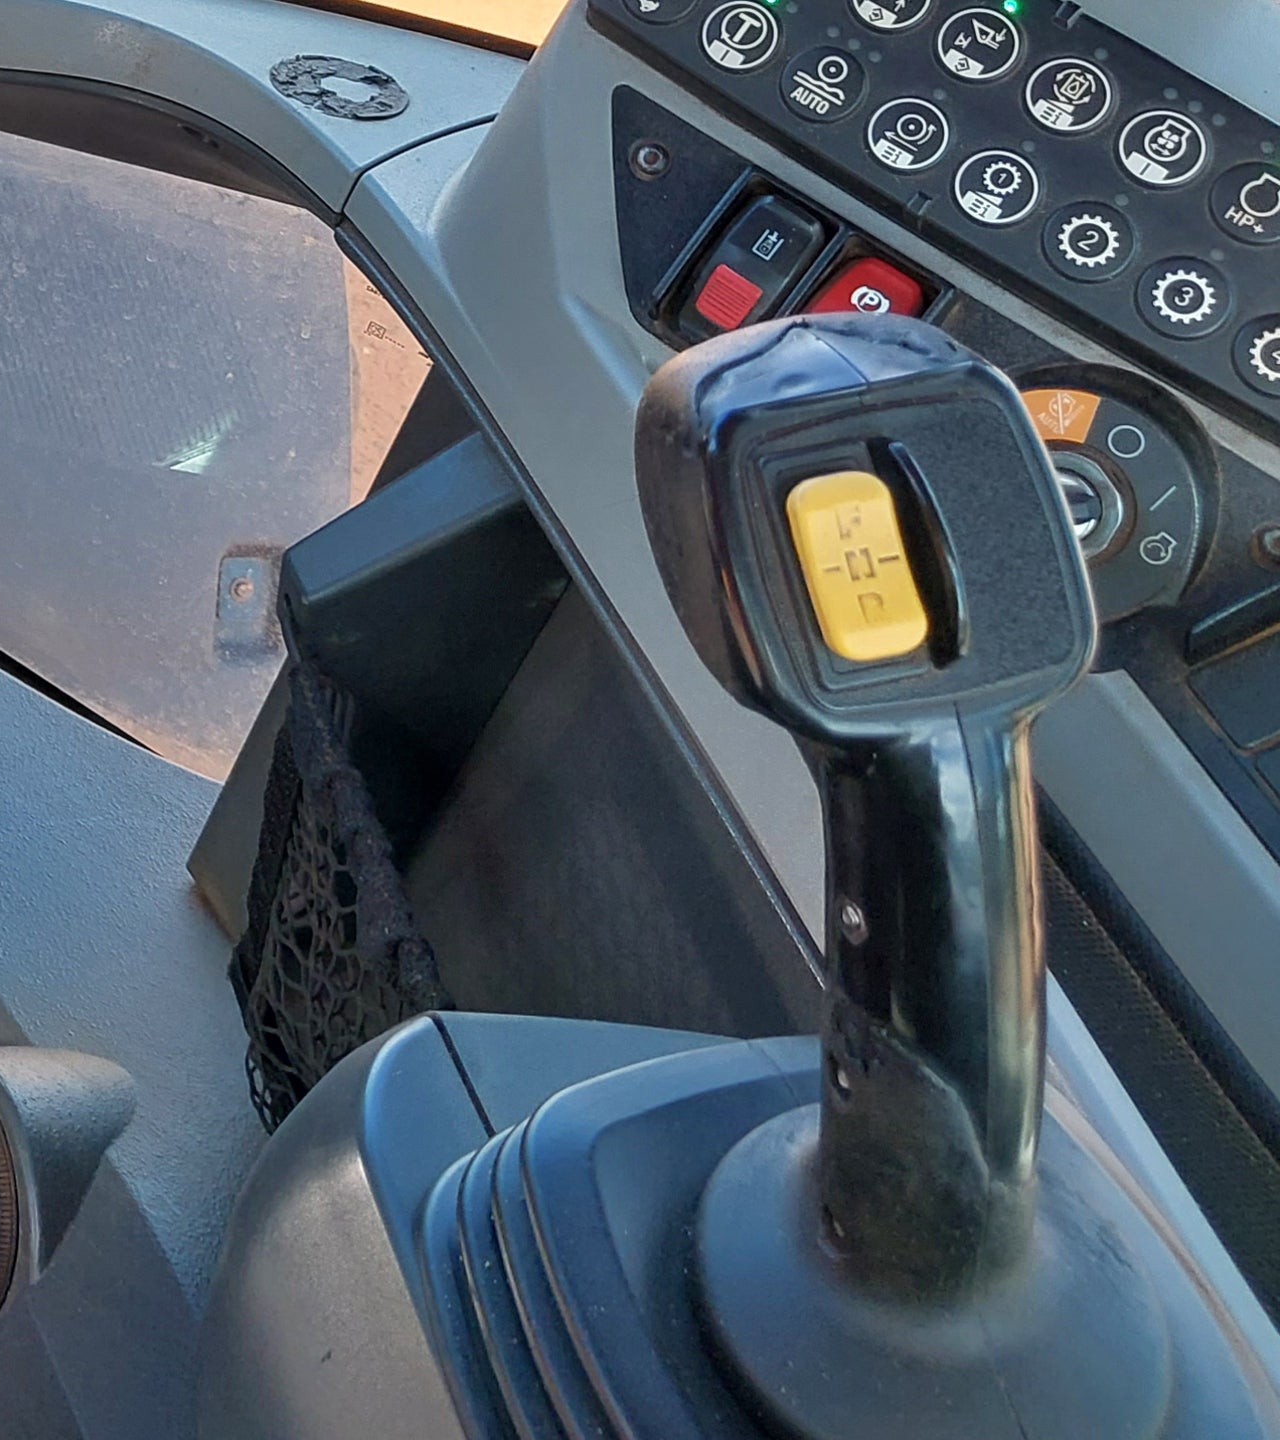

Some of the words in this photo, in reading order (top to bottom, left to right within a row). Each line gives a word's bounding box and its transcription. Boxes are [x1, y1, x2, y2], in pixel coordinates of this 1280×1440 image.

[790, 85, 830, 115] AUTO
[1224, 205, 1265, 235] HP+
[1076, 230, 1100, 252] 2
[1173, 287, 1195, 308] 3
